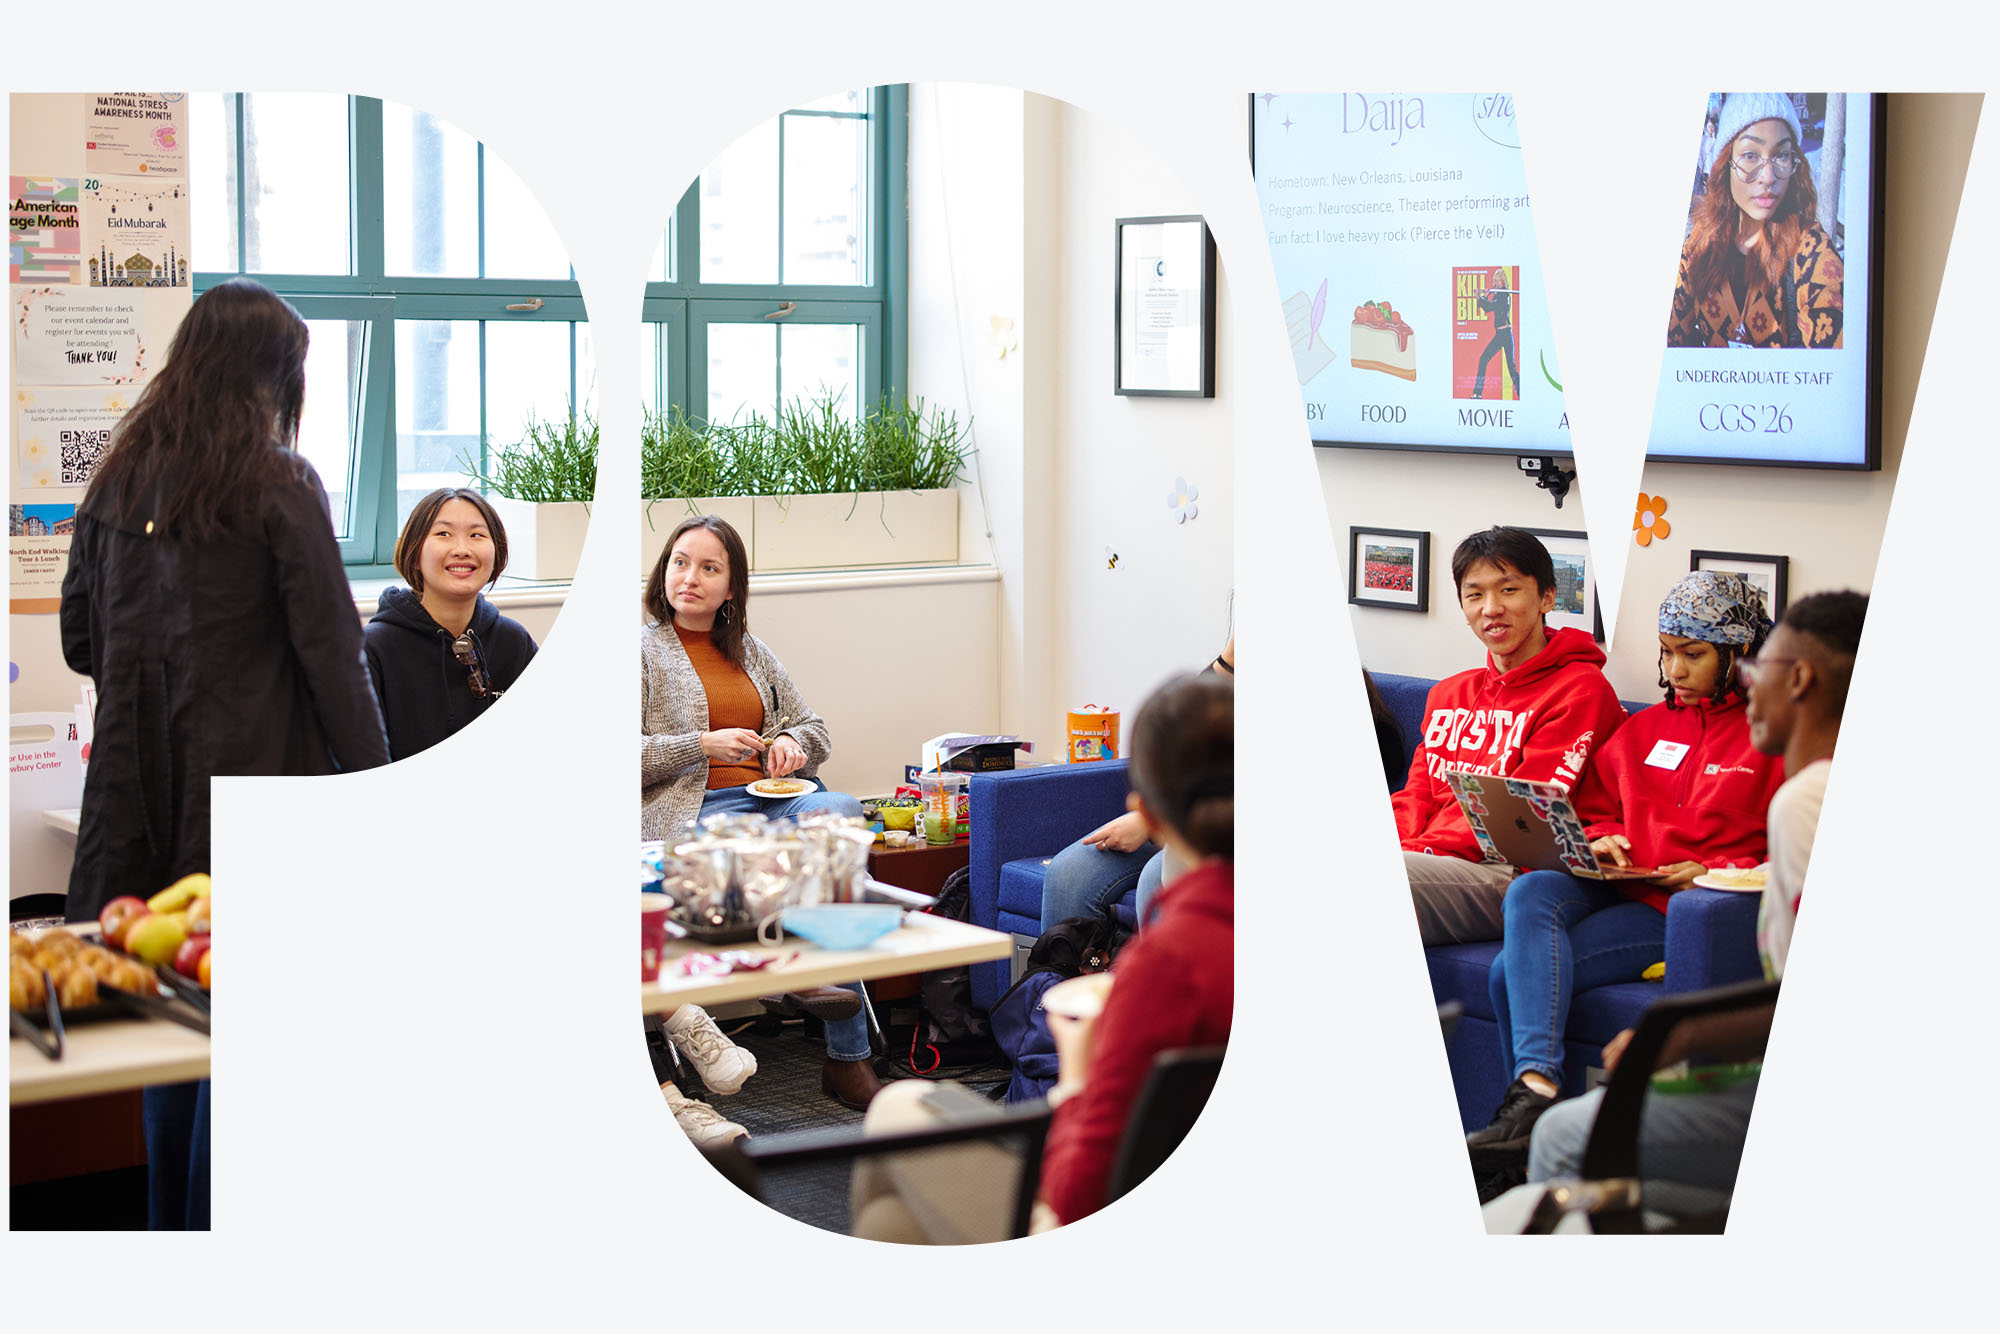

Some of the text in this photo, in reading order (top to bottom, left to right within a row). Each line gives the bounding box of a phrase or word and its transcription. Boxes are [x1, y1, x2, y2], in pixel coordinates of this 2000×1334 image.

[97, 97, 168, 110] NATIONAL STRESS
[94, 108, 172, 120] AWARENESS MONTH
[1342, 92, 1426, 146] Daija
[84, 178, 99, 190] 20
[1268, 168, 1463, 190] Hometown: New Orleans, Louisiana
[14, 198, 78, 213] American
[1268, 202, 1315, 219] Program:
[1318, 200, 1395, 215] Neuroscience,
[1398, 196, 1442, 212] Theater
[1445, 194, 1510, 213] performing
[37, 214, 79, 228] Month
[107, 217, 167, 228] Eid Mubarak
[1267, 231, 1288, 245] Fun
[1290, 230, 1314, 243] fact:
[1322, 229, 1345, 243] love
[1348, 227, 1379, 247] heavy
[1383, 226, 1407, 242] rock
[1410, 225, 1450, 242] (Pierce
[1453, 224, 1473, 240] the
[1476, 224, 1505, 240] Veil)
[85, 316, 114, 324] calendar
[45, 328, 72, 337] register
[109, 329, 122, 337] you
[65, 350, 117, 364] THANK YOU!
[1676, 369, 1834, 385] UNDERGRADUATE STAFF
[1306, 403, 1327, 420] BY
[1361, 404, 1407, 424] FOOD
[1458, 408, 1514, 428] MOVIE
[17, 753, 33, 761] Use
[43, 750, 57, 759] the
[35, 761, 62, 770] Center
